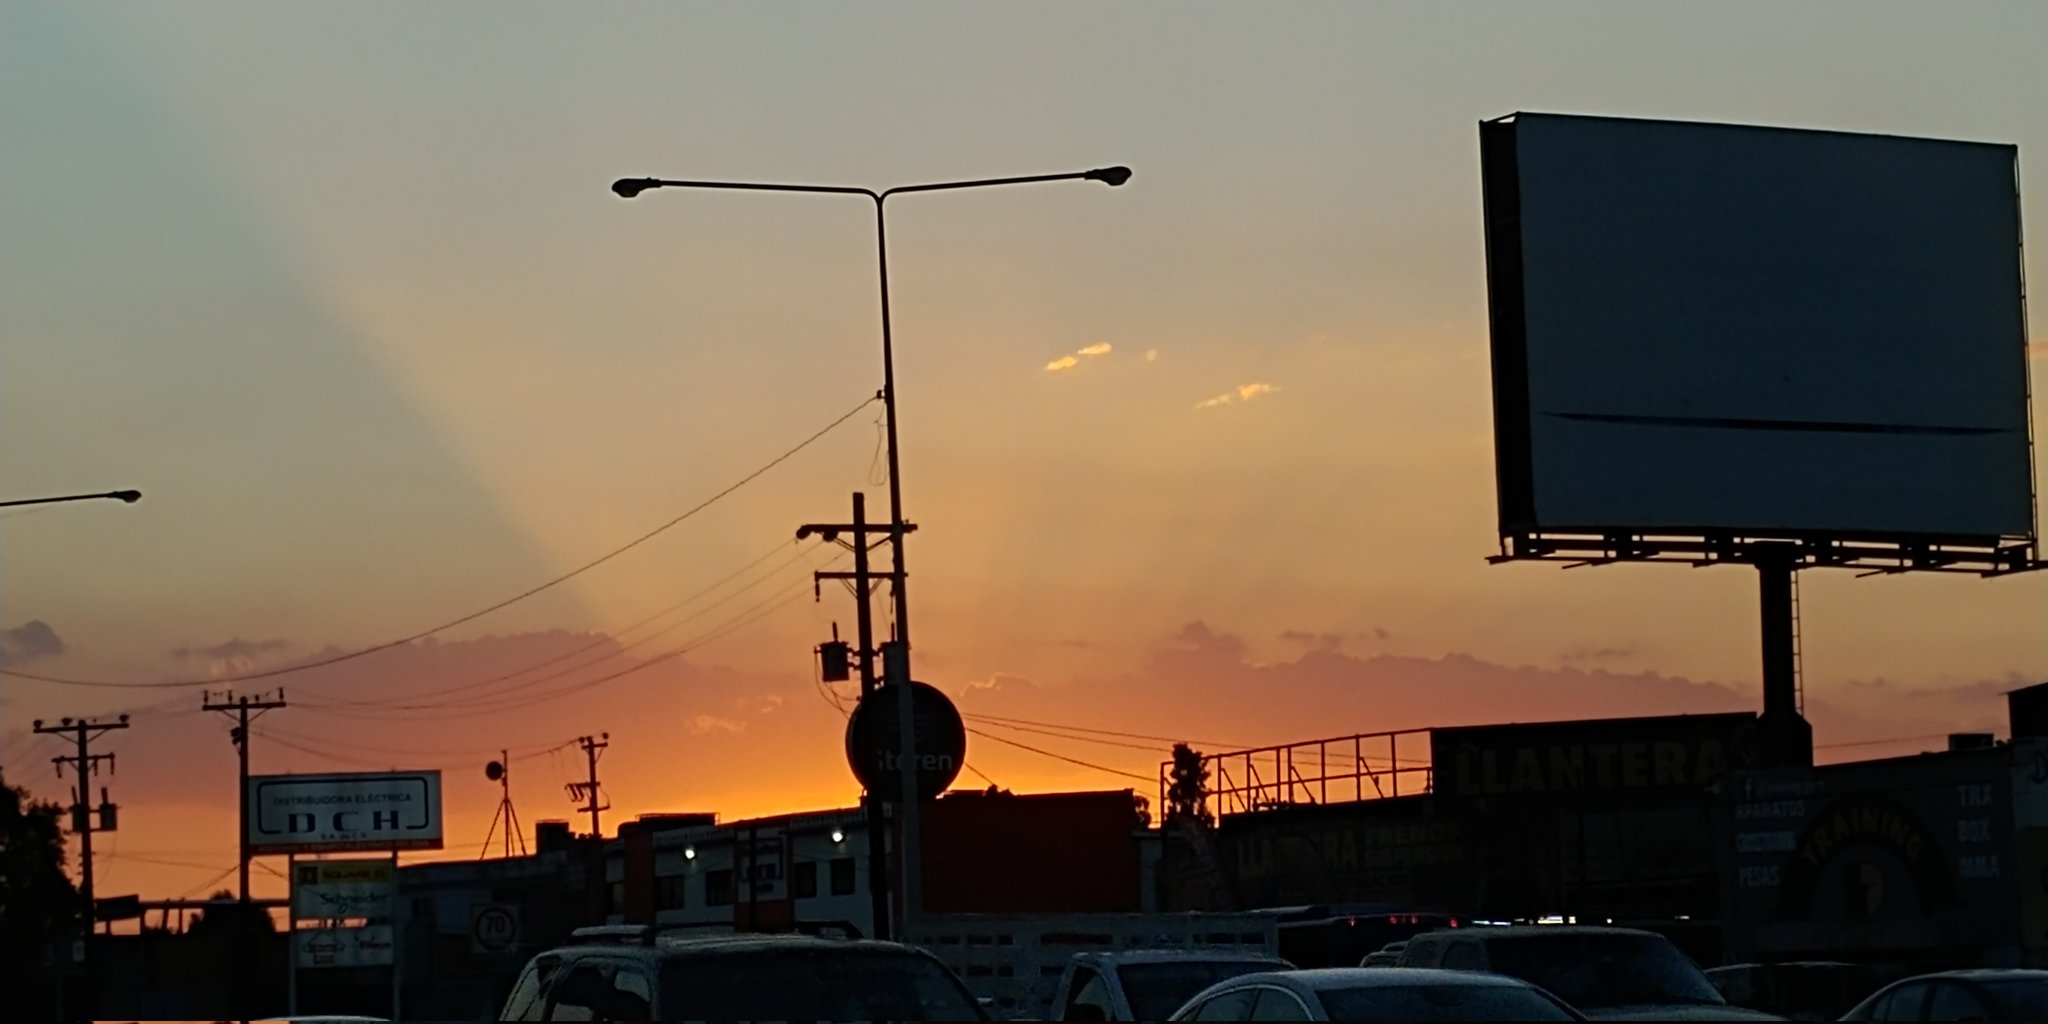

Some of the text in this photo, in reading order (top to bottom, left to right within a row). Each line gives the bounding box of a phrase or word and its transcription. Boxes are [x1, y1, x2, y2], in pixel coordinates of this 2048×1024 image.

[1454, 737, 1728, 796] LLANTERA
[273, 796, 353, 806] DISTRIBUIDORA
[1956, 783, 1993, 807] TRX
[1735, 800, 1806, 819] APARATOS
[1800, 803, 1924, 865] TRAINING
[1957, 818, 1991, 843] BOX
[1738, 865, 1781, 887] PESAS
[320, 891, 389, 914] Schneider
[485, 916, 505, 934] 70
